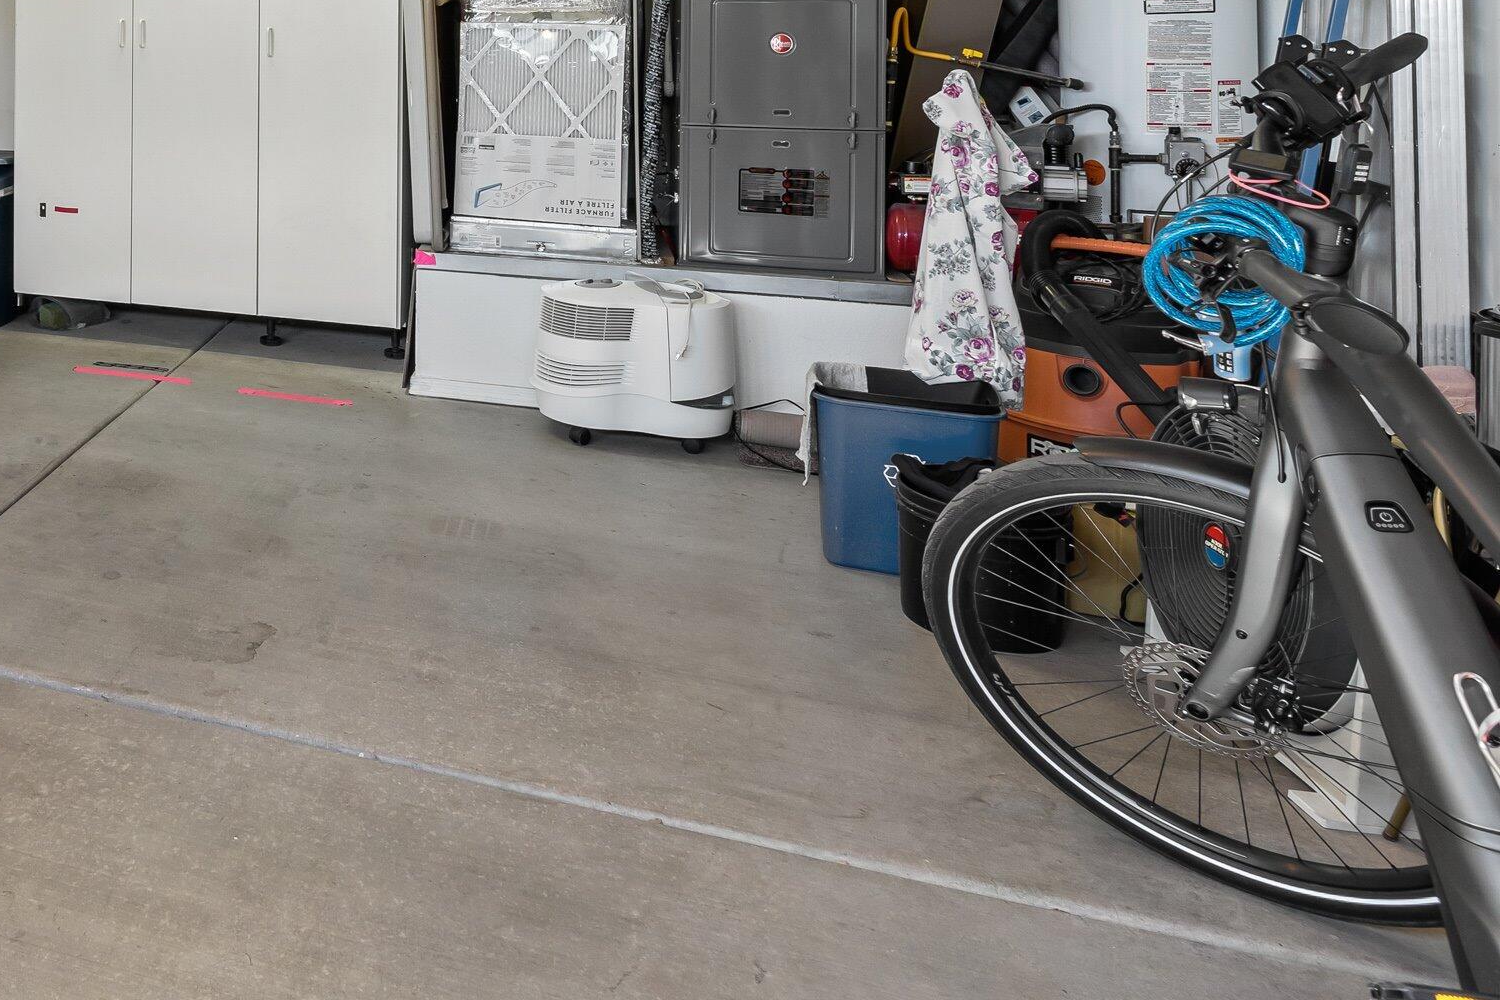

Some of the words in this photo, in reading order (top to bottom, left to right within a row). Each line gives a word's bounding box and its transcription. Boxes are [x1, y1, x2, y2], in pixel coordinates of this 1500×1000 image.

[587, 201, 615, 209] FILTRE
[544, 206, 573, 214] FILTER
[575, 209, 614, 217] FURNACE
[1073, 275, 1112, 284] RIDGID
